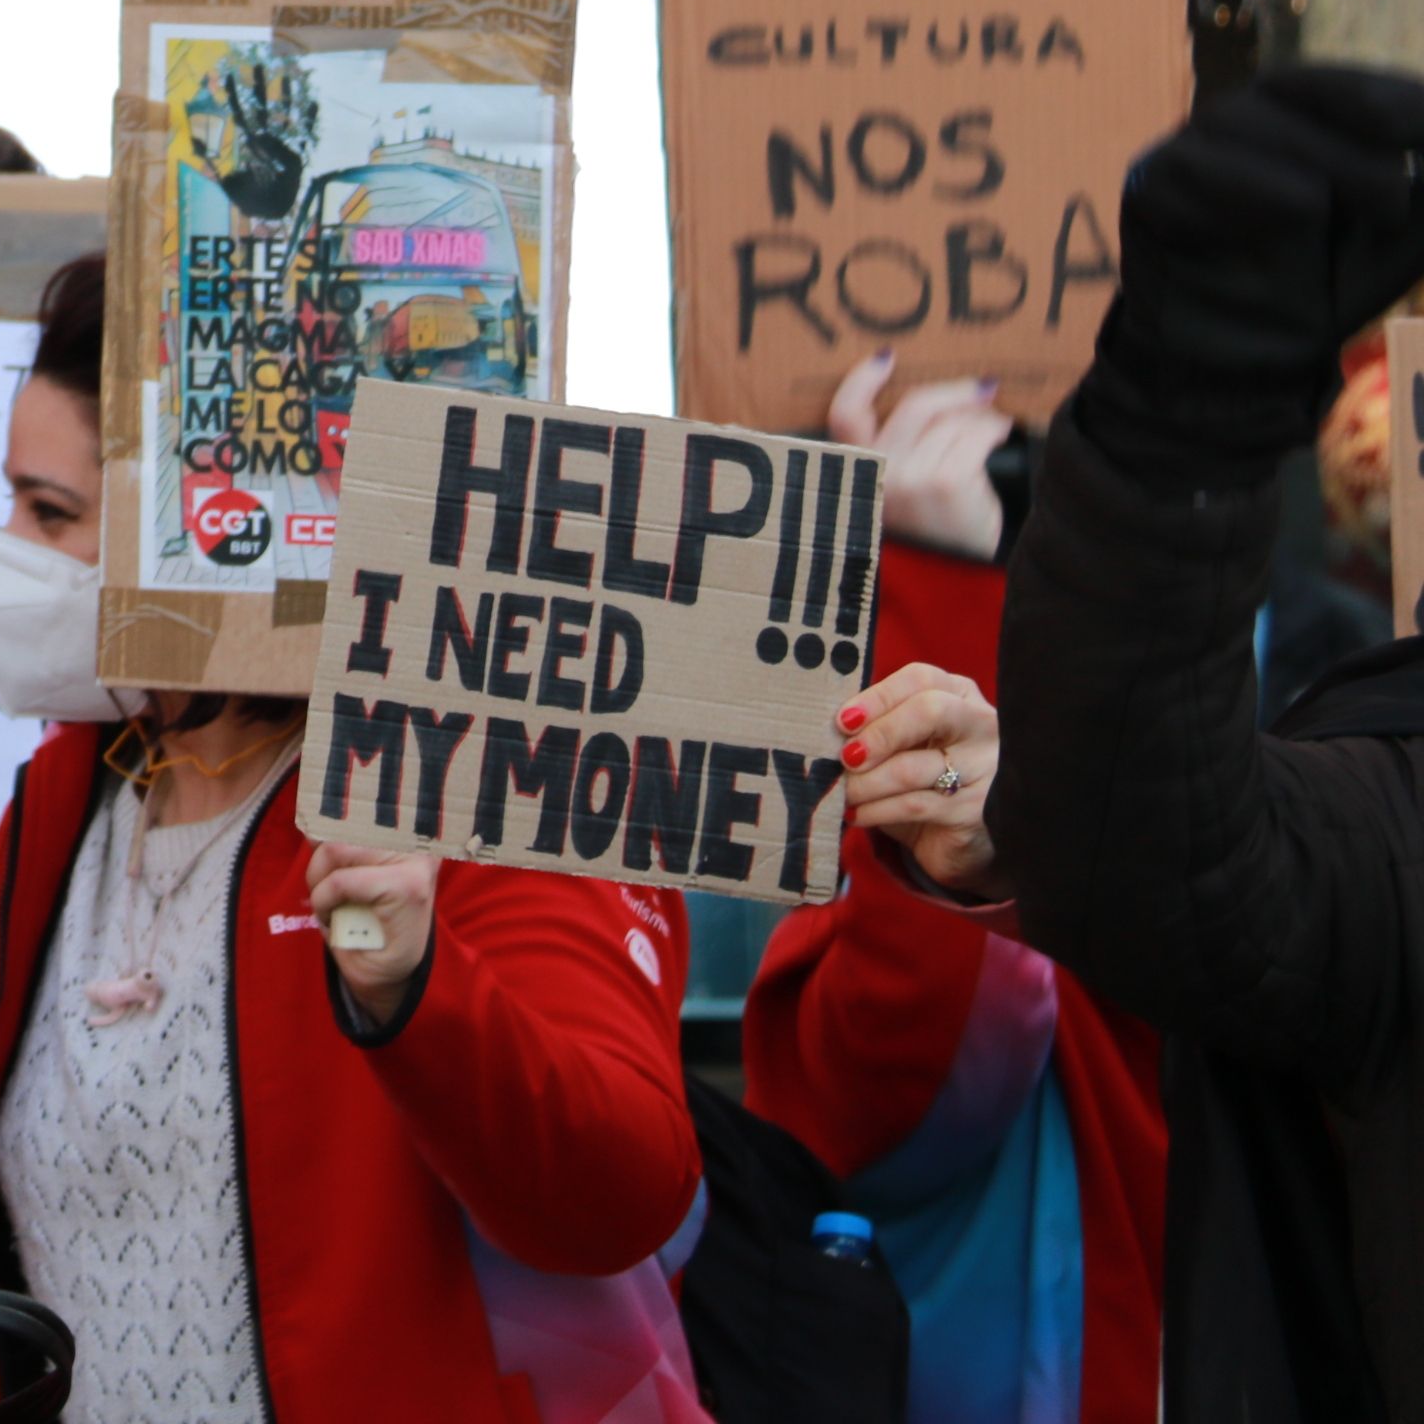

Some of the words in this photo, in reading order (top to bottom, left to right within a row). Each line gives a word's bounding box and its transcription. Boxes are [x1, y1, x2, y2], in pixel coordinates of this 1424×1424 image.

[707, 16, 1087, 72] CULTURA
[766, 110, 1006, 220] NOS
[190, 236, 284, 271] ERTE
[354, 230, 403, 266] SAD
[411, 230, 486, 266] XMAS
[734, 192, 1120, 355] ROBA
[189, 278, 283, 311] ERTE
[297, 279, 362, 314] NO
[186, 316, 359, 354] MAGMA
[187, 358, 235, 391] LA
[185, 397, 247, 433] ME
[256, 399, 311, 435] LO
[183, 437, 323, 476] COMO
[200, 509, 264, 536] CGT
[429, 406, 879, 674] HELP!!!
[229, 540, 262, 556] BBT
[346, 570, 402, 676] I
[426, 586, 645, 714] NEED
[319, 691, 474, 838] MY
[473, 716, 848, 893] MONEY
